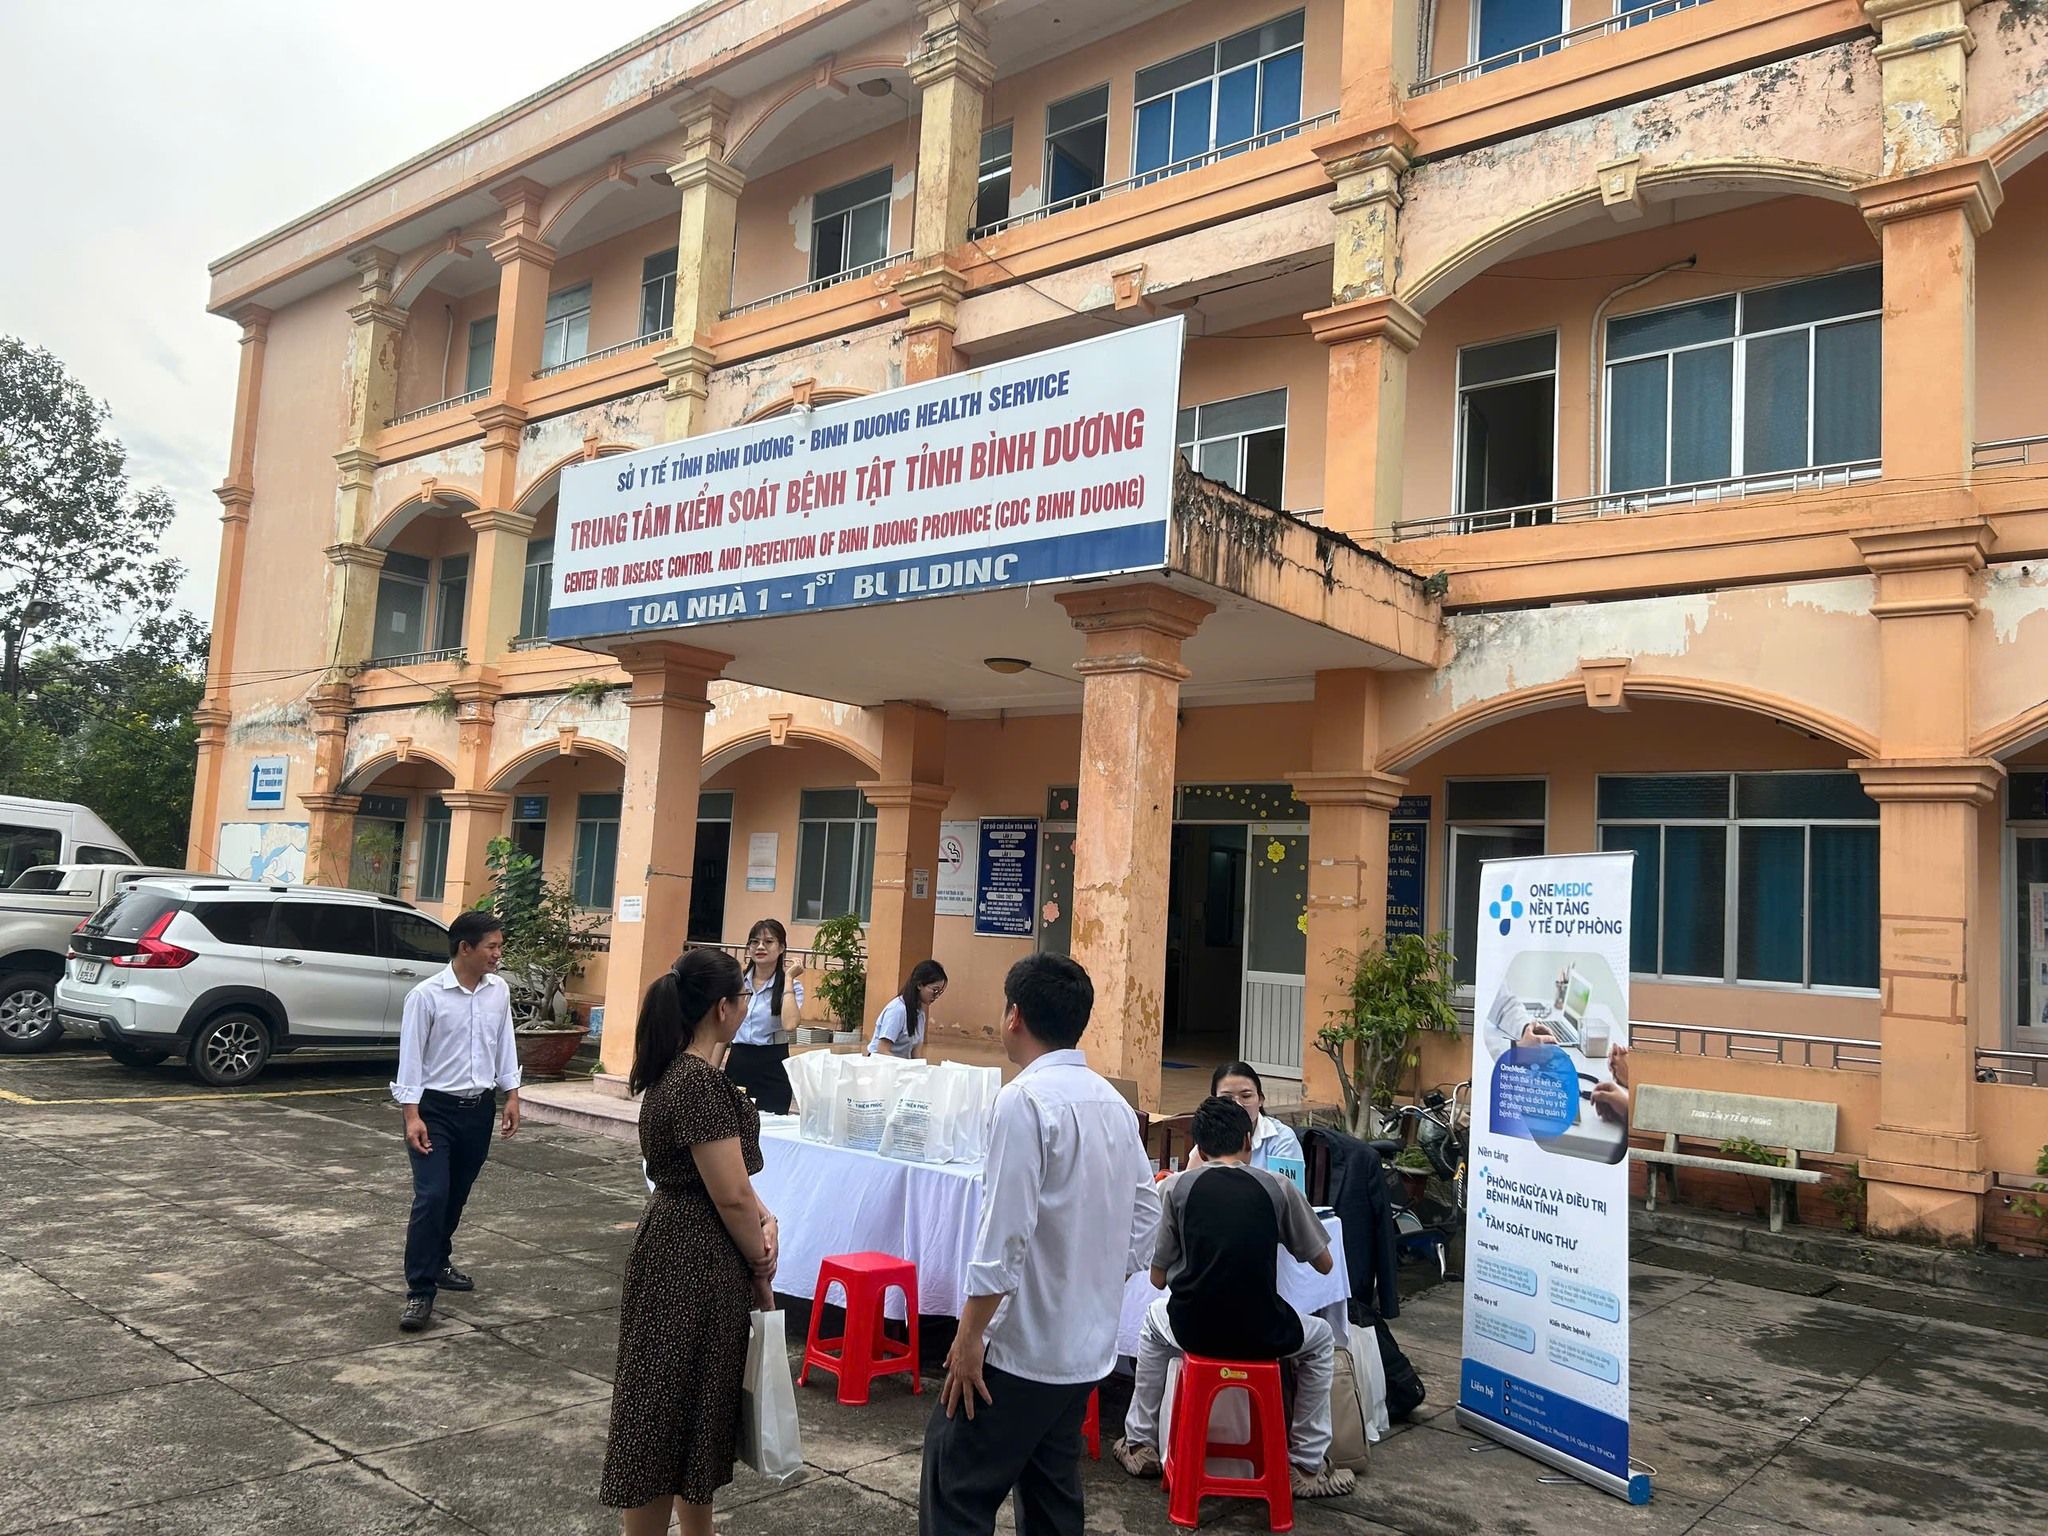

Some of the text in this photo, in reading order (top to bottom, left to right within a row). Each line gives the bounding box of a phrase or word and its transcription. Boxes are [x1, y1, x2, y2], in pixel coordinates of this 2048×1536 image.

[618, 463, 634, 492] SỞ
[640, 469, 650, 488] Y
[651, 456, 668, 485] TẾ
[672, 453, 702, 481] TỈNH
[705, 448, 740, 475] BÌNH
[743, 434, 794, 466] DƯƠNG
[810, 422, 848, 451] BINH
[853, 408, 910, 442] DUONG
[915, 391, 982, 428] HEALTH
[988, 370, 1070, 412] SERVICE
[570, 408, 1145, 551] TRUNG TÂM KIỂM SOÁT BỆNH TẬT TỈNH BÌNH DƯƠNG
[564, 475, 1145, 593] CENTER FOR DISEASE CONTROL AND PREVENTION OF BINH DUONG PROVINCE (CDC BINH DUONG)
[687, 586, 746, 620] NHÀ
[756, 588, 768, 611] 1
[1391, 829, 1416, 841] ẾT
[1530, 883, 1593, 897] ONEMEDIC
[1529, 898, 1589, 915] NỀN TẢNG
[1528, 916, 1622, 937] Y TẾ DỰ PHÒNG
[1478, 1146, 1508, 1163] Nền tảng
[1486, 1174, 1607, 1216] PHÒNG NGỪA VÀ ĐIỀU TRỊ
[1486, 1188, 1558, 1216] BỆNH MÃN TÍNH
[1486, 1213, 1578, 1250] TẦM SOÁT UNG THƯ
[1470, 1379, 1494, 1399] Liên hệ
